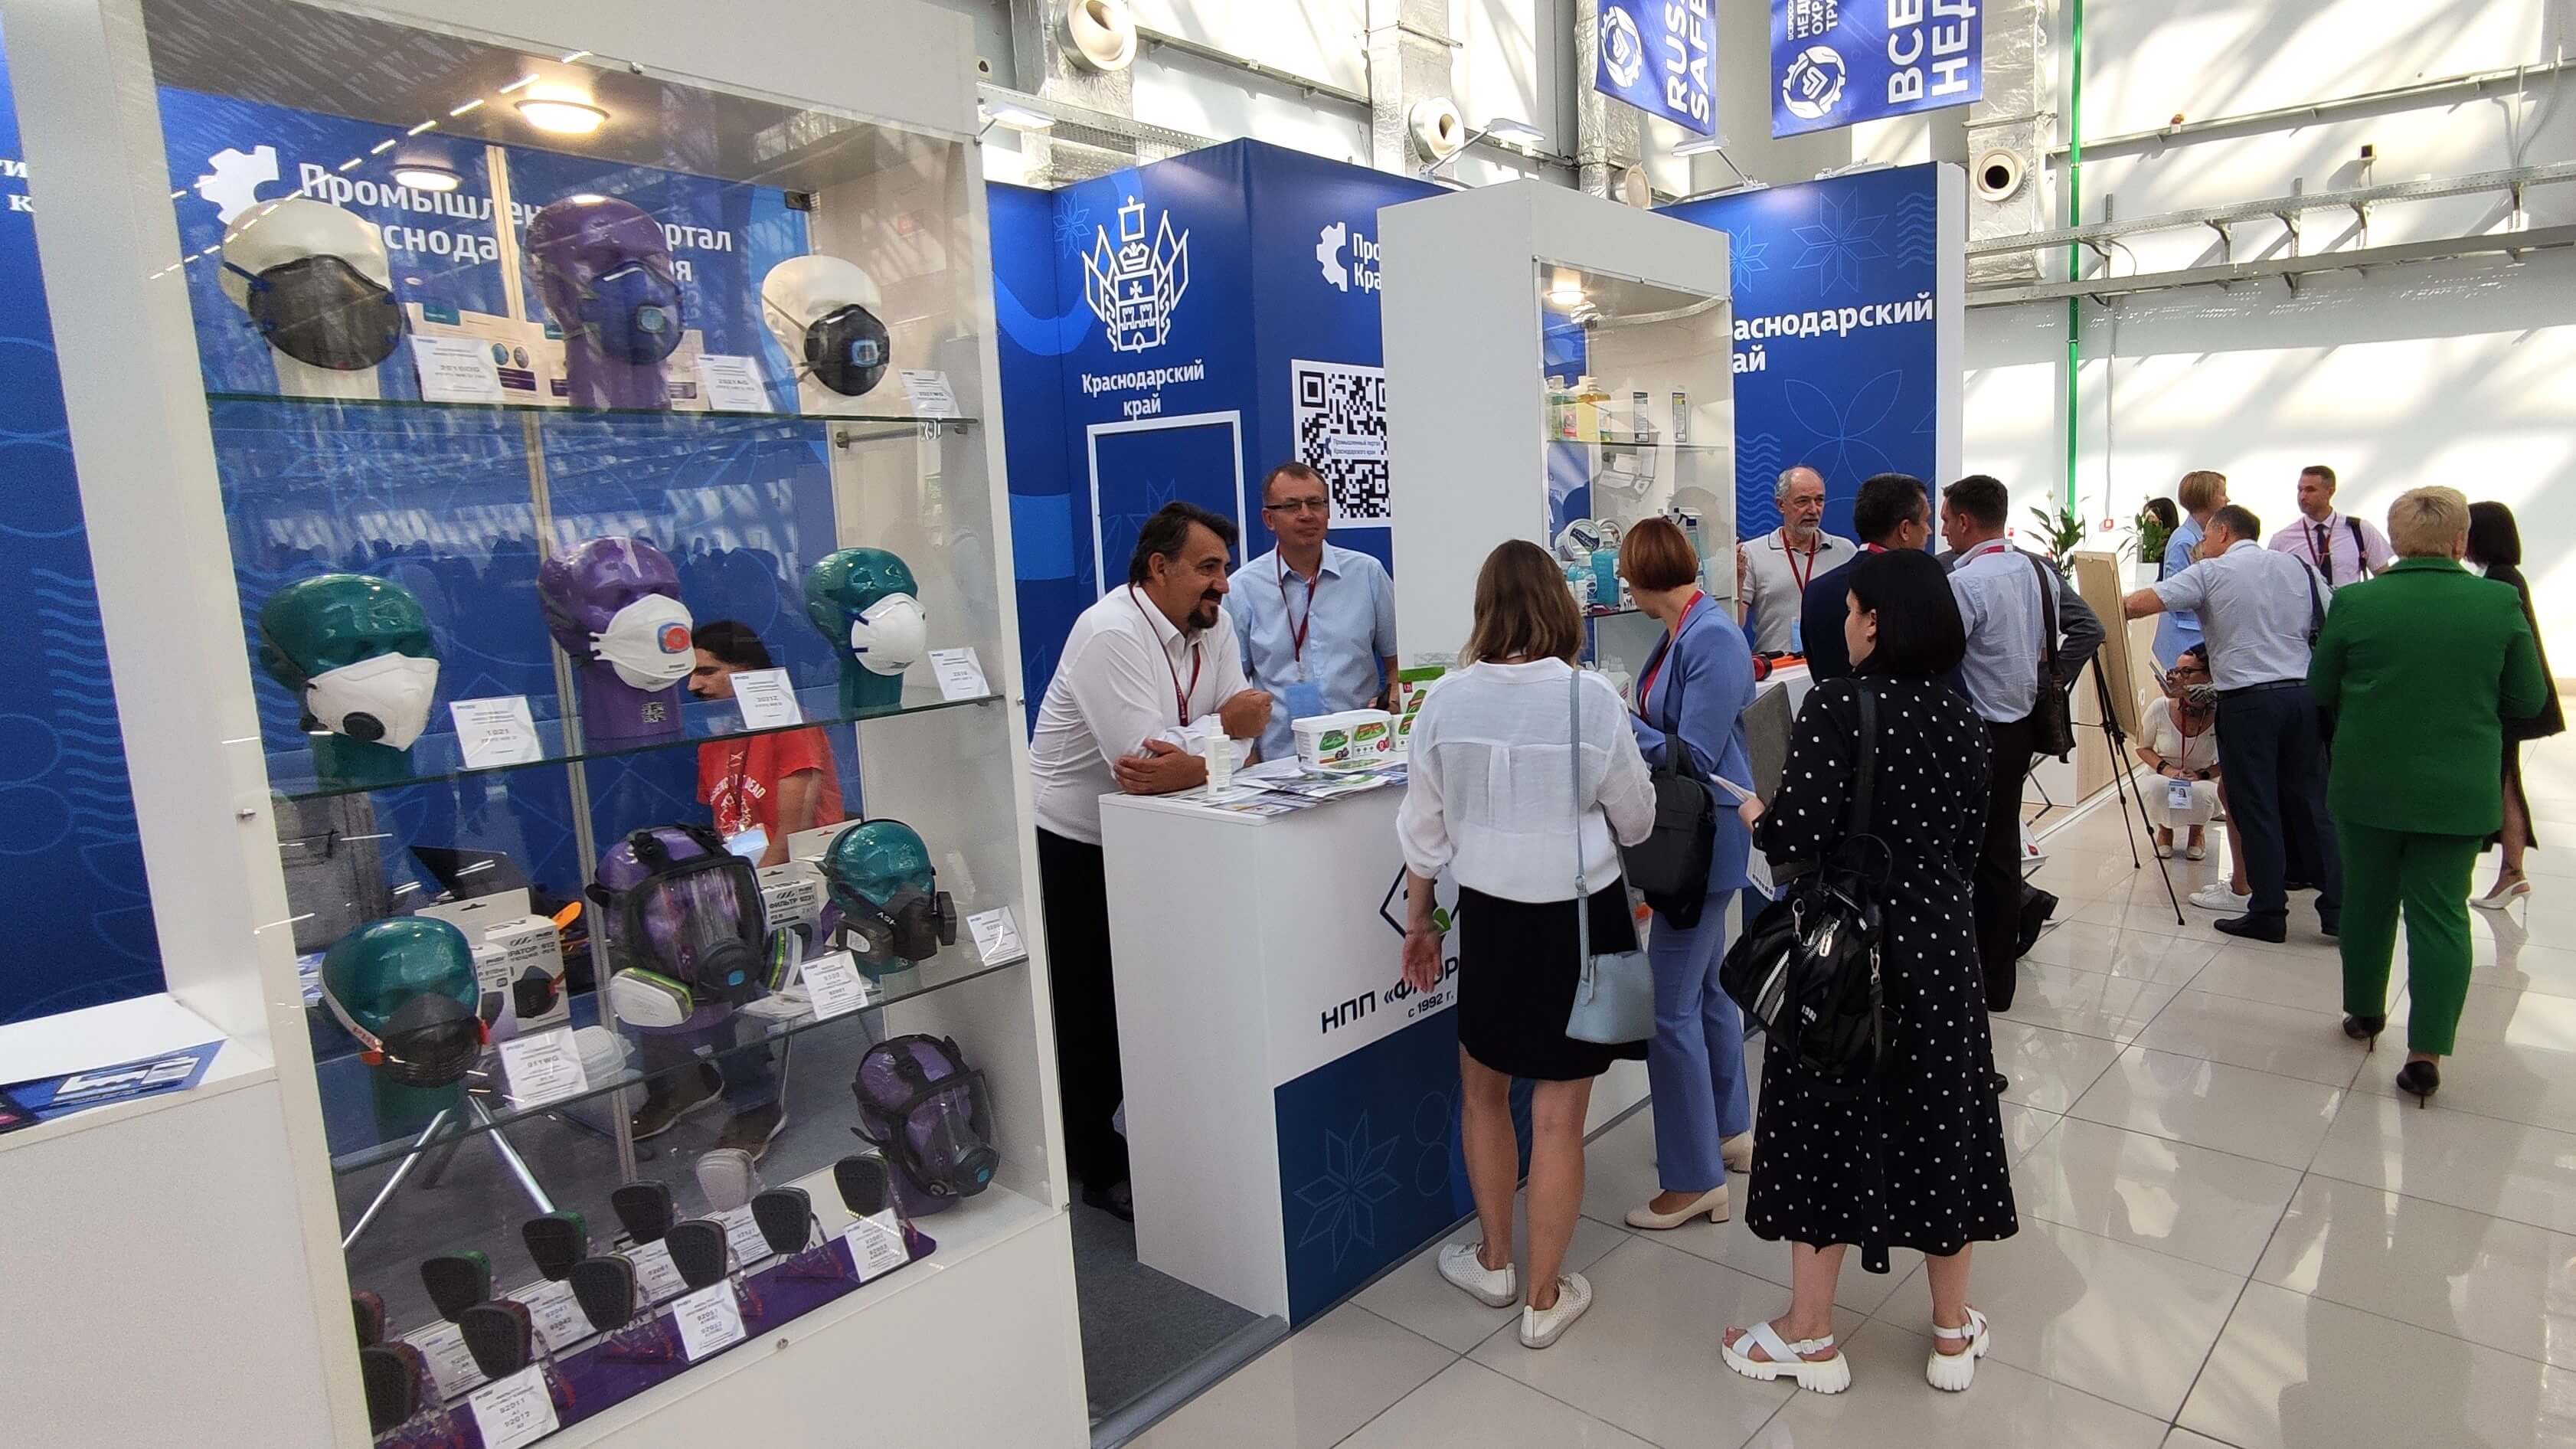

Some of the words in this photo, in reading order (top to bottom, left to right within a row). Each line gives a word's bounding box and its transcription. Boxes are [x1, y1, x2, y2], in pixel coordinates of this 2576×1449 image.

[1666, 0, 1688, 114] RUS
[299, 162, 542, 225] Промышлен
[660, 222, 732, 252] ртал
[383, 224, 499, 264] снода
[1353, 232, 1381, 265] Про
[1354, 262, 1381, 295] Кра
[1733, 291, 1934, 341] аснодарский
[1081, 358, 1205, 398] Краснодарский
[1732, 344, 1767, 374] ай
[1123, 392, 1162, 421] край
[1321, 989, 1376, 1035] НПП
[1407, 1008, 1415, 1019] с
[1417, 993, 1443, 1014] 1992
[1446, 990, 1454, 1002] г.
